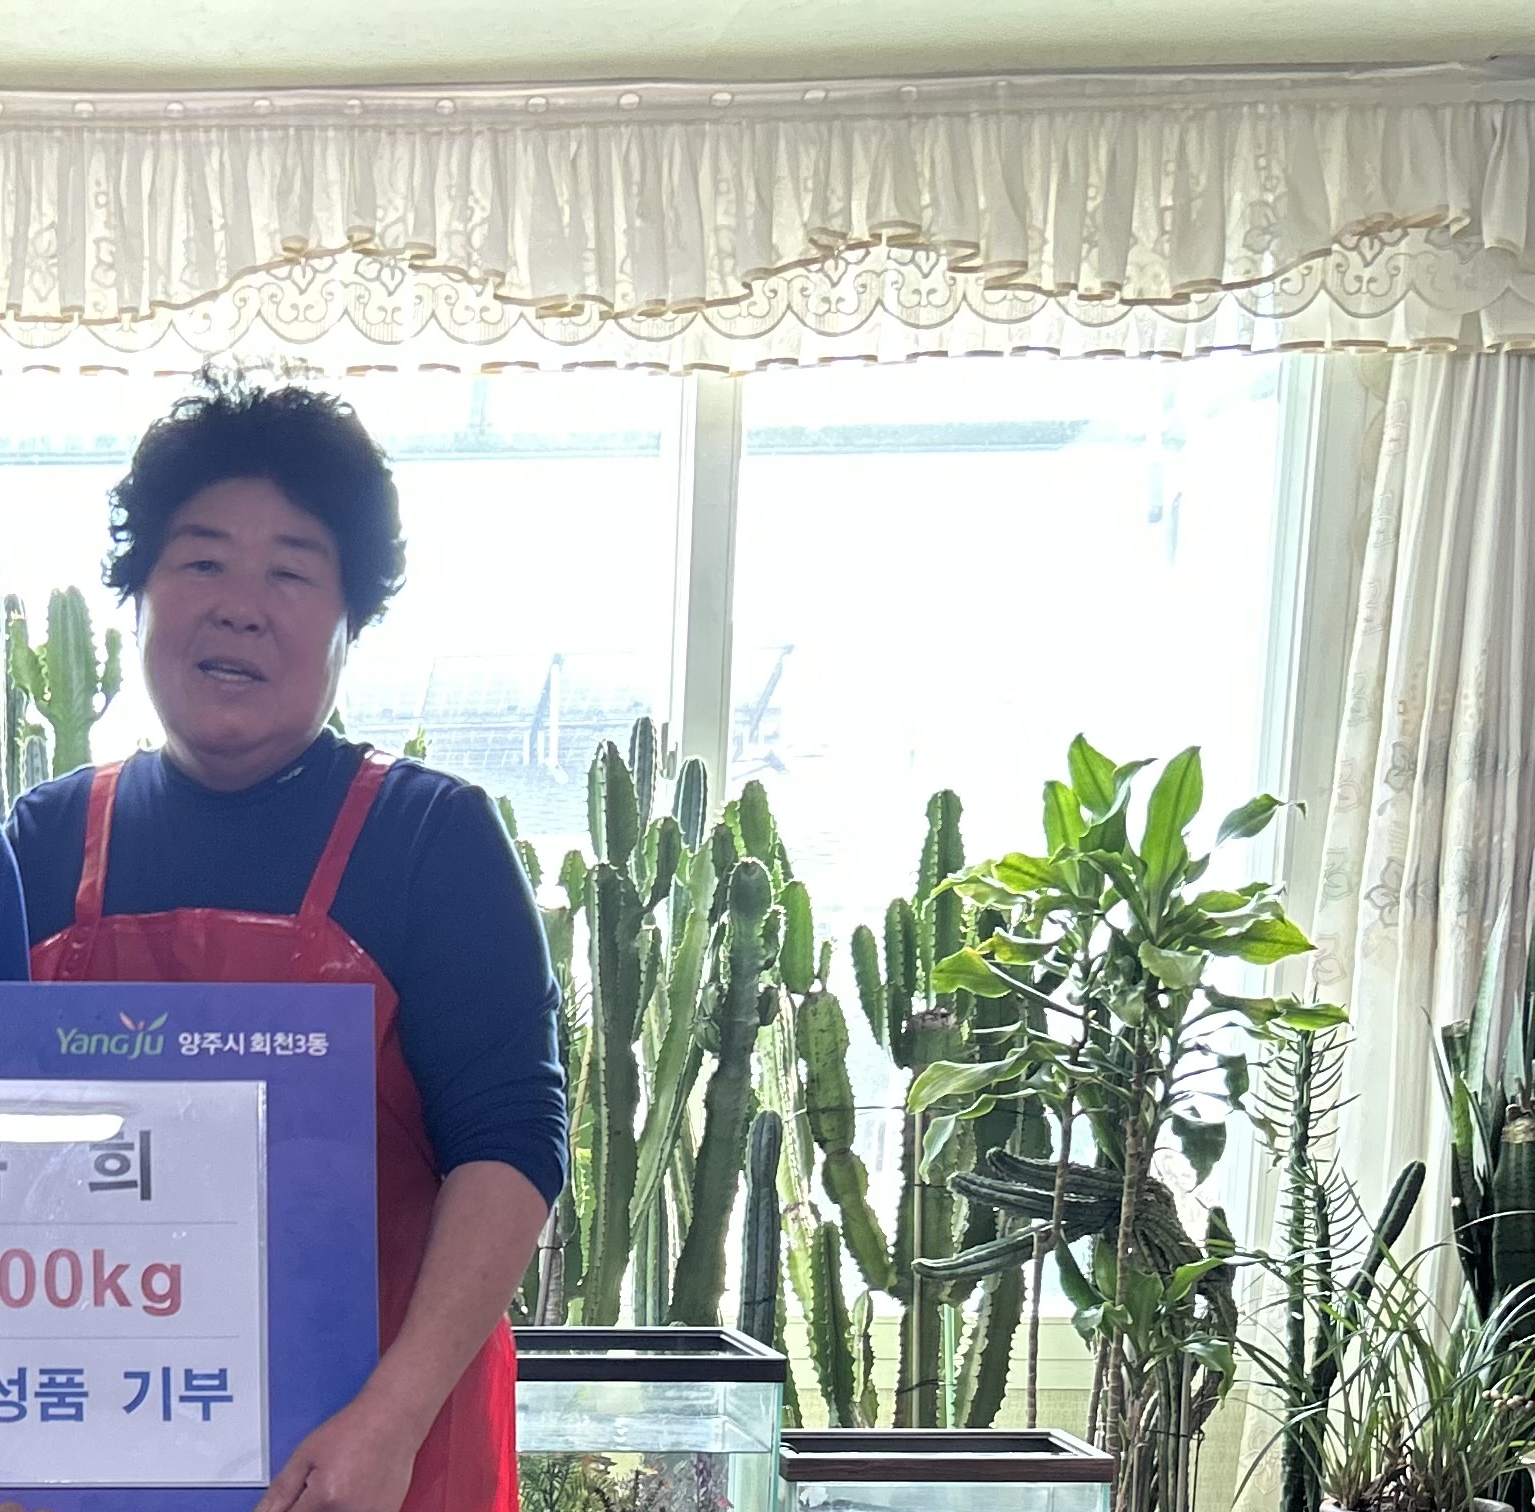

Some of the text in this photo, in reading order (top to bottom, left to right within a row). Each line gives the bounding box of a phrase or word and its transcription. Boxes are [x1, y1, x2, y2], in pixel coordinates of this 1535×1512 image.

[178, 1031, 330, 1057] 양주시 회천3동
[87, 1130, 152, 1201] 희
[122, 1365, 234, 1422] 기부
